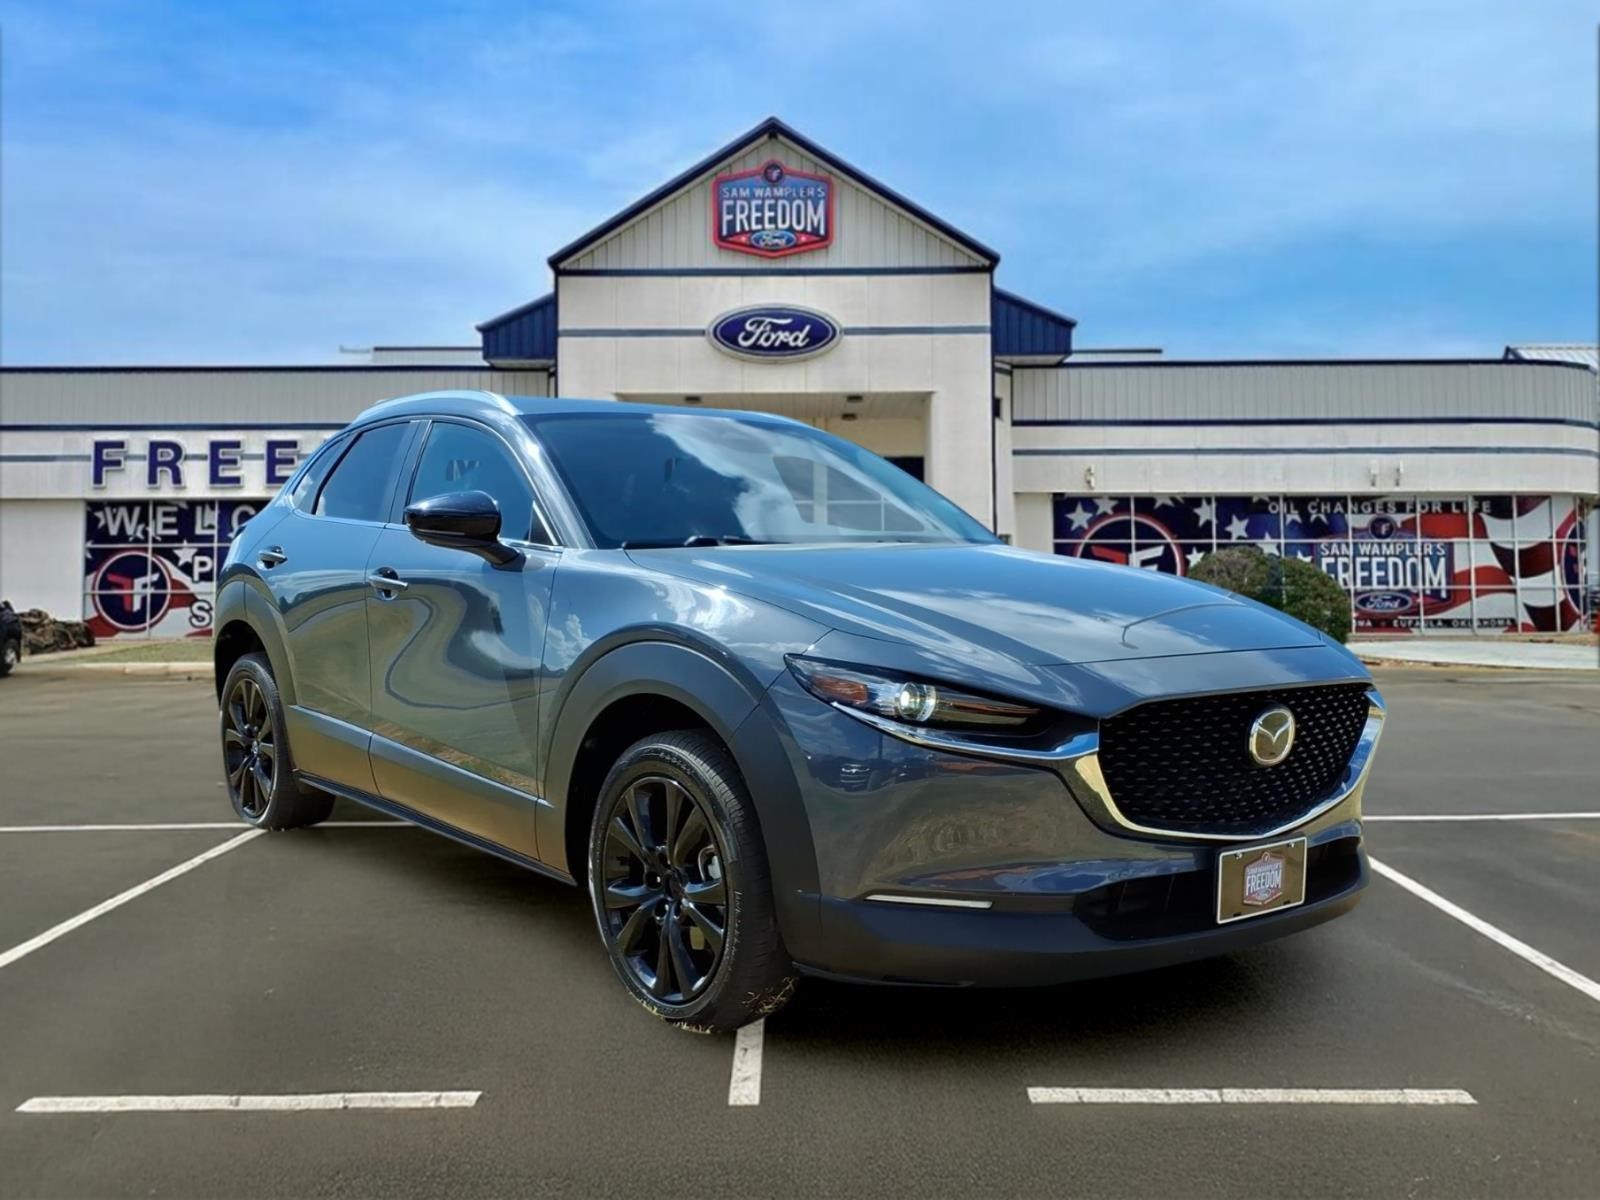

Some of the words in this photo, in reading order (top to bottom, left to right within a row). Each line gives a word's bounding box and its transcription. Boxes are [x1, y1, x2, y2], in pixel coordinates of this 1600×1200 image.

[722, 187, 750, 198] SAM
[722, 200, 825, 236] FREEDOM
[738, 316, 811, 348] Ford
[92, 440, 299, 486] FREE
[103, 504, 256, 537] WELC
[1268, 501, 1299, 514] OIL
[1307, 501, 1397, 514] CHANGES
[1406, 501, 1442, 514] FOR
[1451, 500, 1492, 514] LIFE
[1320, 543, 1352, 556] SAM
[1321, 556, 1447, 599] FREEDOM
[1365, 595, 1401, 609] Ford
[1245, 869, 1282, 897] FREEDOM
